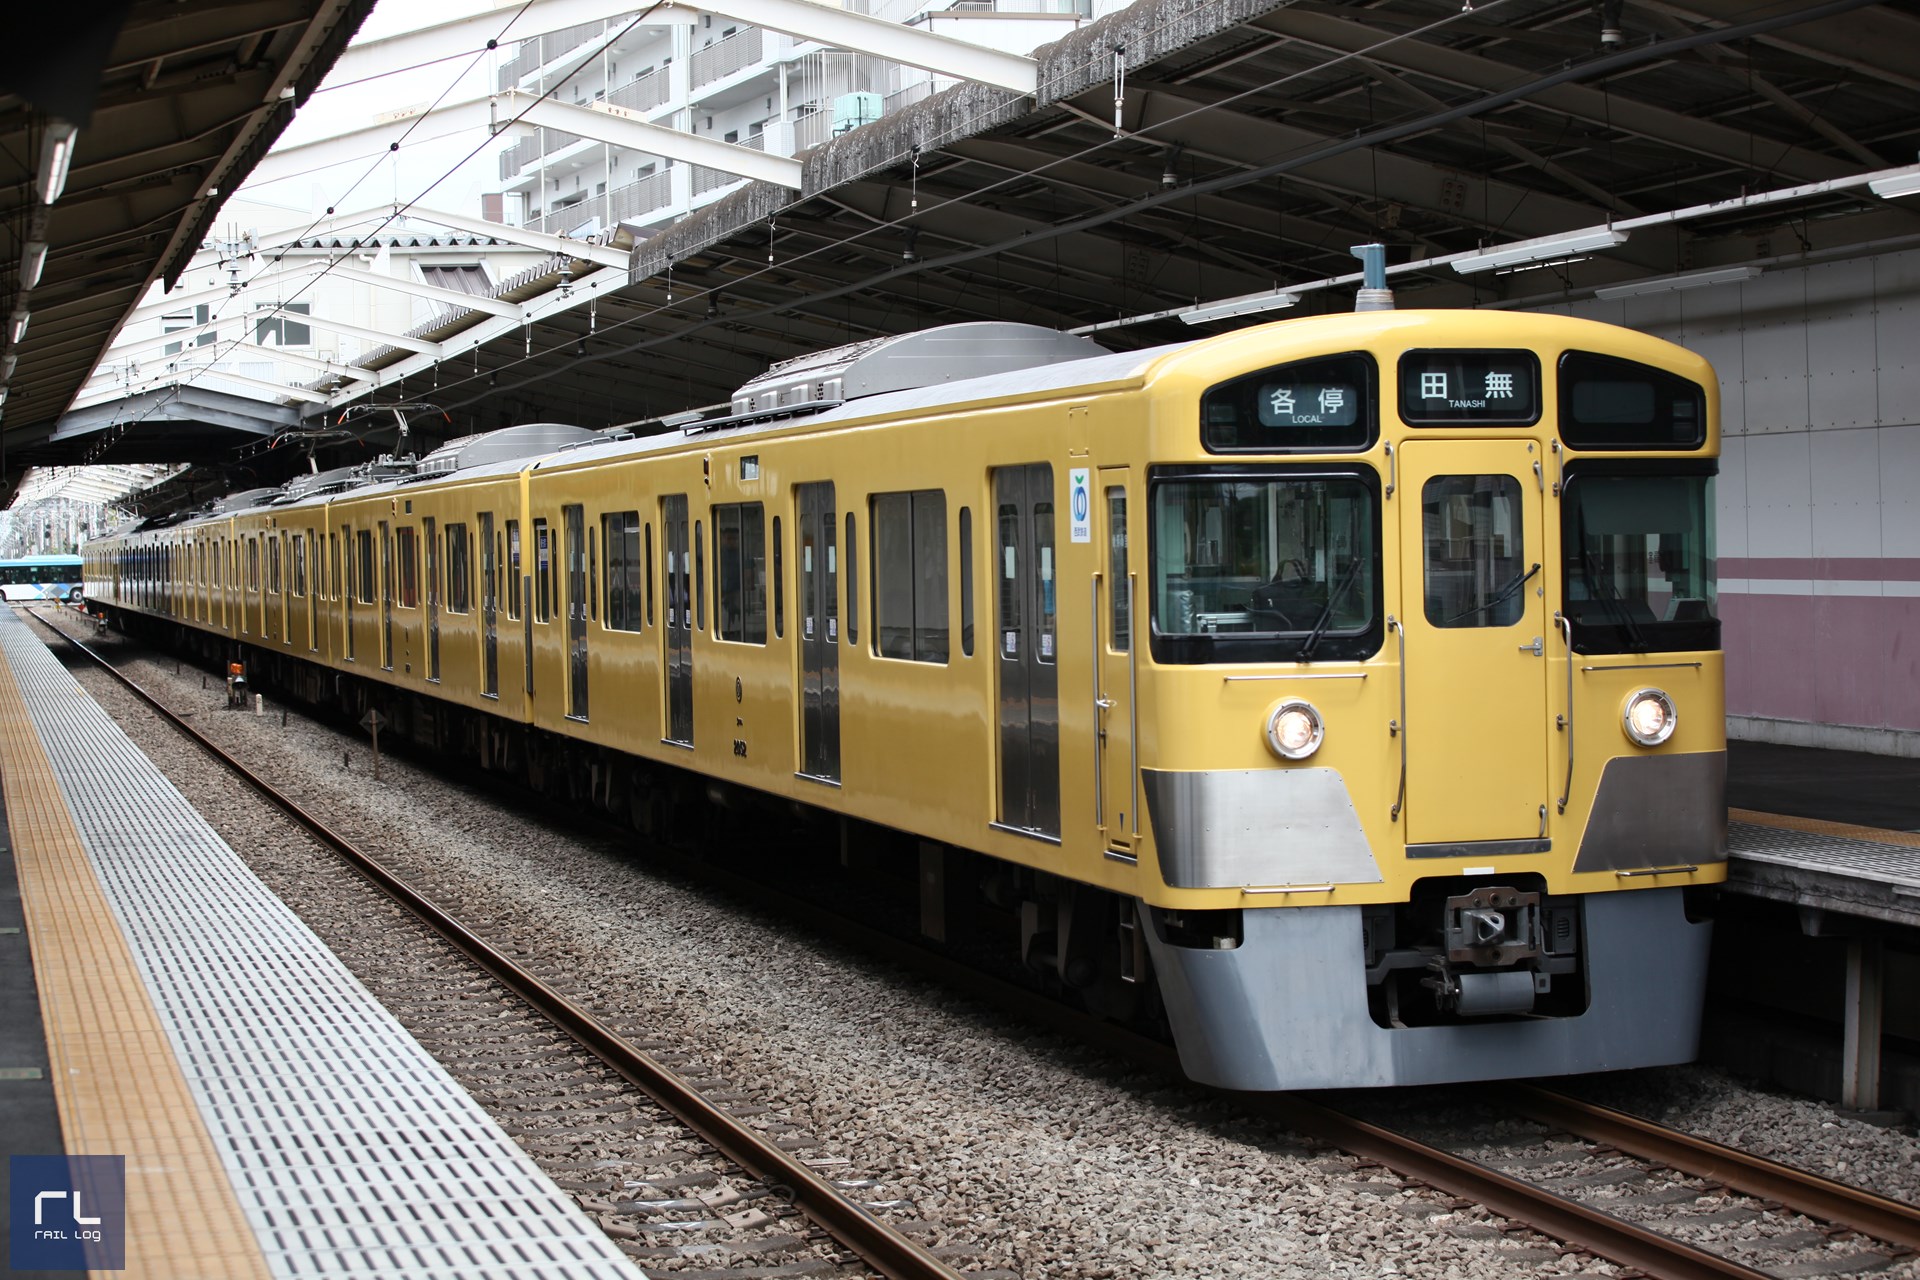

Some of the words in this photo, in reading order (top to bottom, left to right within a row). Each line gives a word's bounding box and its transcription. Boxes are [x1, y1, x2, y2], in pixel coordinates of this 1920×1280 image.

[1421, 371, 1513, 399] 田無
[1270, 387, 1344, 415] 各停
[1448, 400, 1486, 408] TANASHI
[1292, 415, 1322, 424] LOCAL
